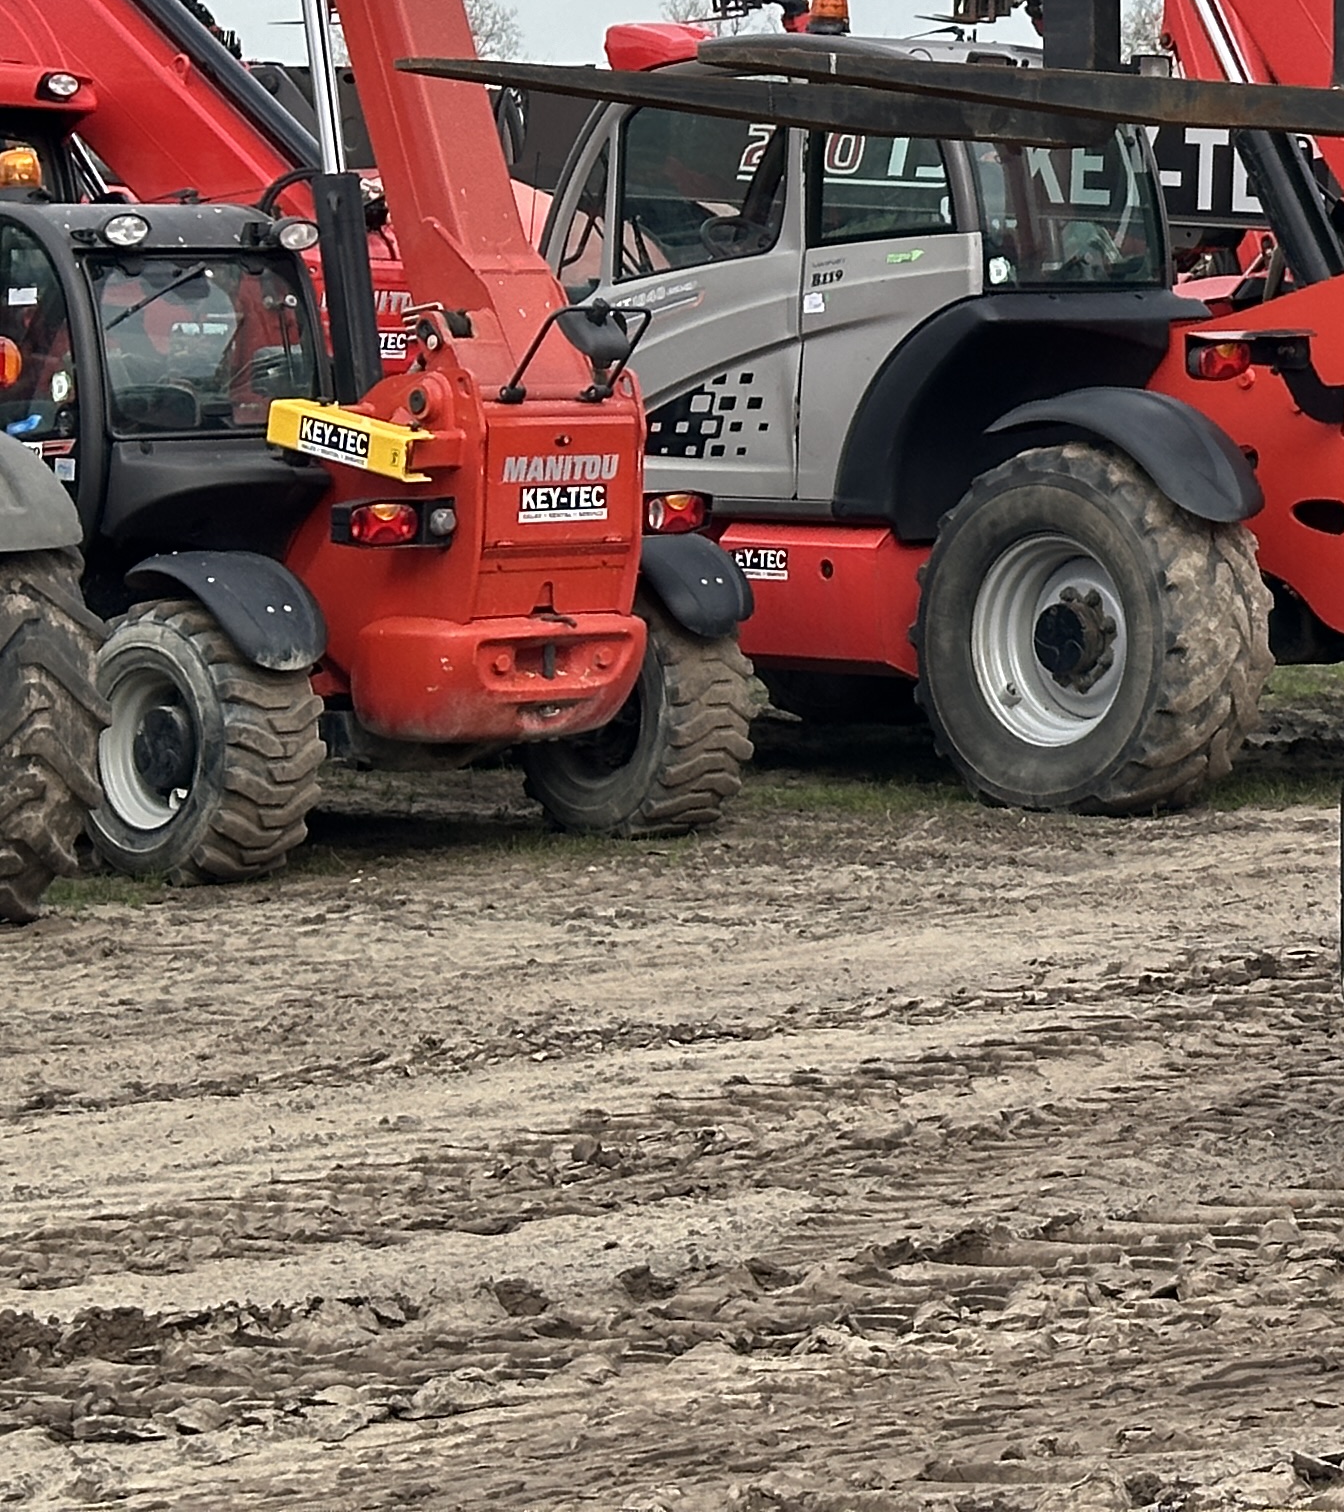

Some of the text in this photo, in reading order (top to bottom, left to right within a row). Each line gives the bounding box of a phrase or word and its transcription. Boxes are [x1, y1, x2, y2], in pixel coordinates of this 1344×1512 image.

[1024, 125, 1322, 213] KEY-TE
[301, 417, 369, 456] KEY-TEC
[502, 454, 620, 483] MANITOU
[521, 485, 606, 509] KEY-TEC
[734, 548, 787, 569] EY-TEC
